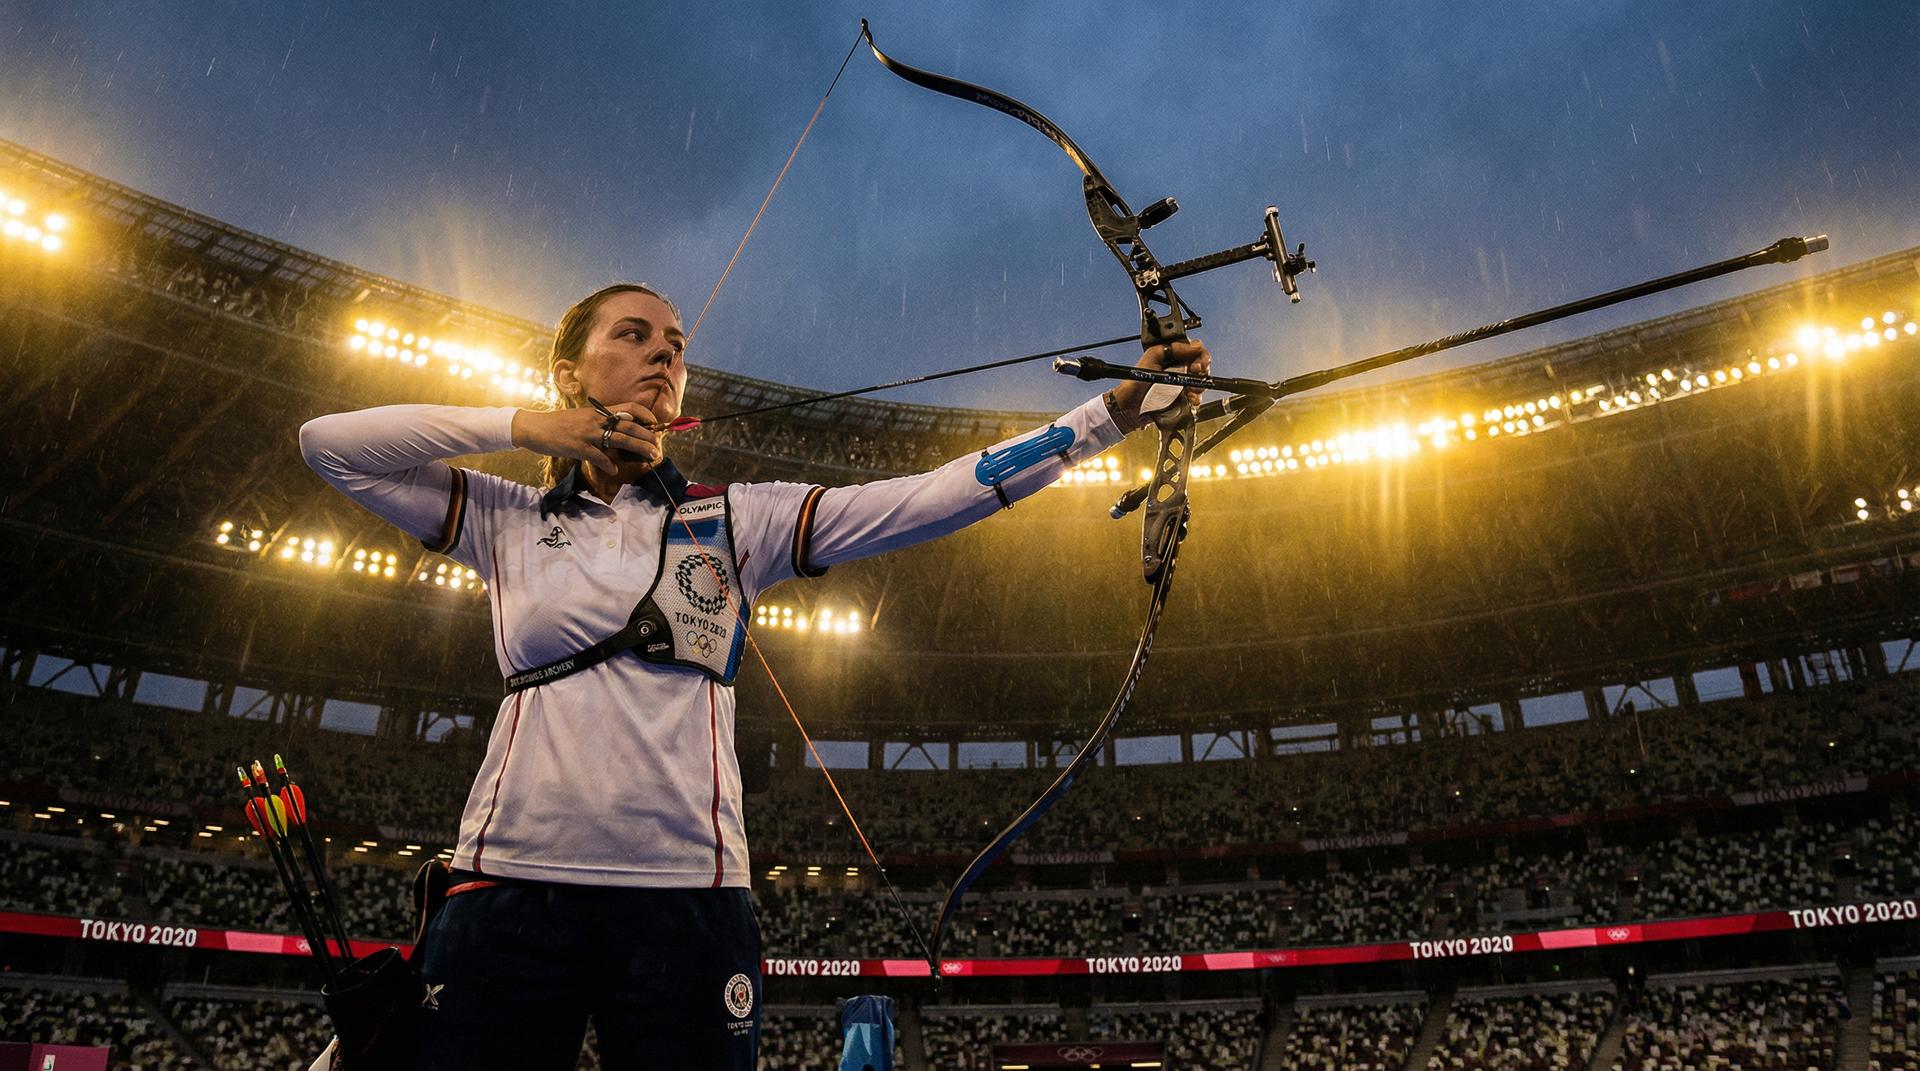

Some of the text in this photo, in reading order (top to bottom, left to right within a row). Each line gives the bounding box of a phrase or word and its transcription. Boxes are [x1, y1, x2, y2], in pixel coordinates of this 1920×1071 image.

[680, 501, 723, 514] OLYMPIC
[675, 611, 709, 630] TOKYO
[1755, 783, 1845, 802] TOKYO 2020
[1026, 851, 1069, 865] TOKYO
[1788, 900, 1918, 929] TOKYO 2020
[80, 919, 197, 948] TOKYO 2020
[1410, 935, 1514, 959] TOKYO 2020
[765, 959, 861, 977] TOKYO 2020
[1086, 956, 1182, 974] TOKYO 2020
